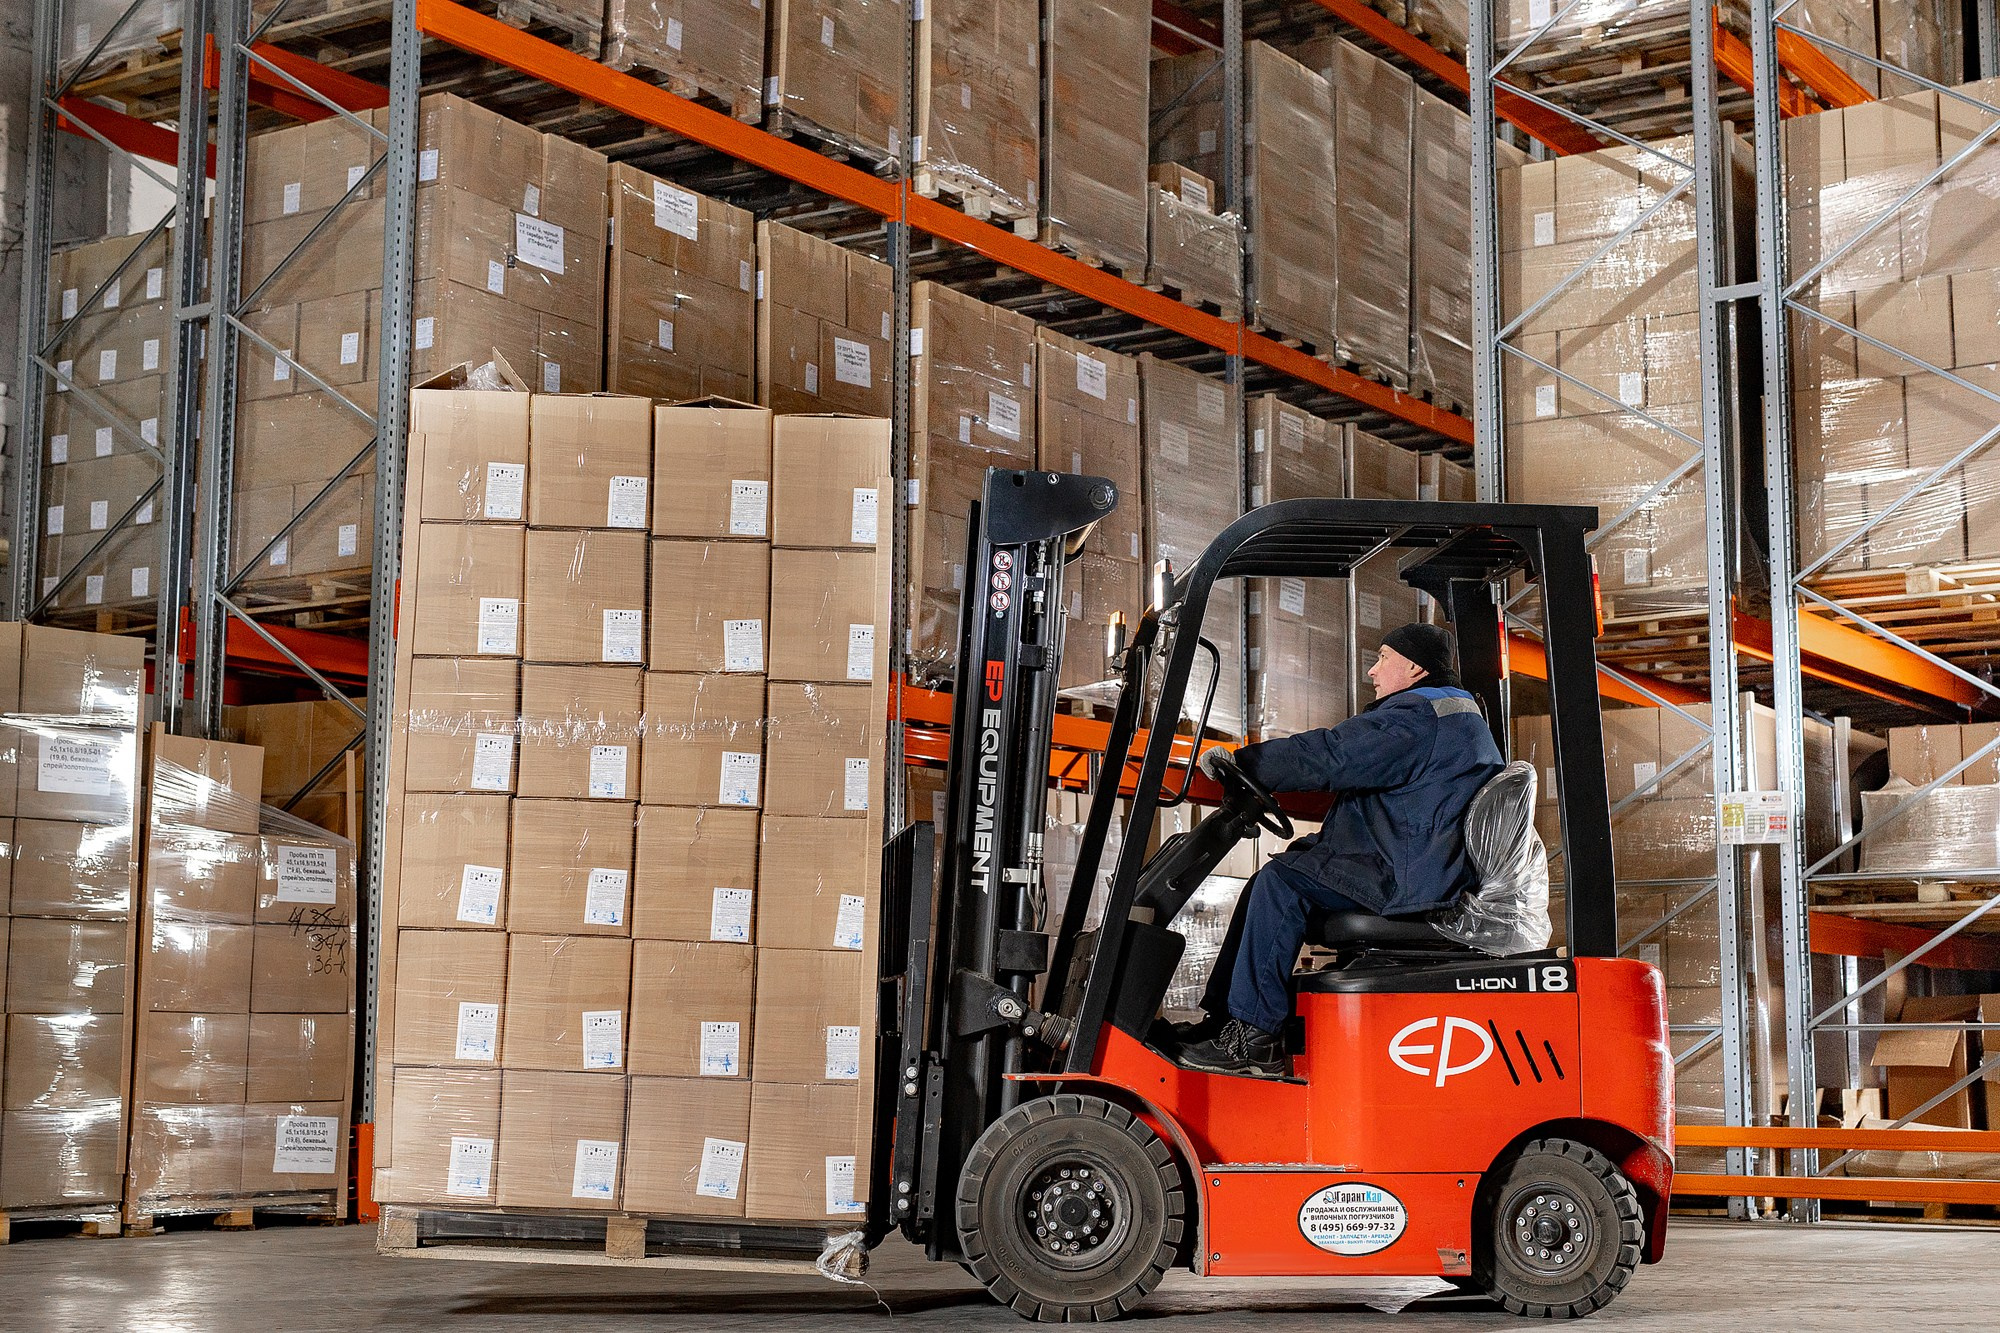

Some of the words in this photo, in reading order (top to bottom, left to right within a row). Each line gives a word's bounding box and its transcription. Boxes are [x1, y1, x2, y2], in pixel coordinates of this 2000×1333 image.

[985, 660, 1005, 702] EP
[970, 708, 1002, 895] EQUIPMENT
[1527, 965, 1569, 992] 18
[1387, 1015, 1495, 1088] EP
[1306, 1206, 1339, 1214] ПРОДАЖА
[1345, 1205, 1399, 1213] ОБСЛУЖИВАНИЕ
[1337, 1190, 1383, 1204] ГарантКар
[1310, 1223, 1316, 1232] 8
[1318, 1223, 1344, 1233] (495)
[1346, 1222, 1396, 1232] 669-97-32
